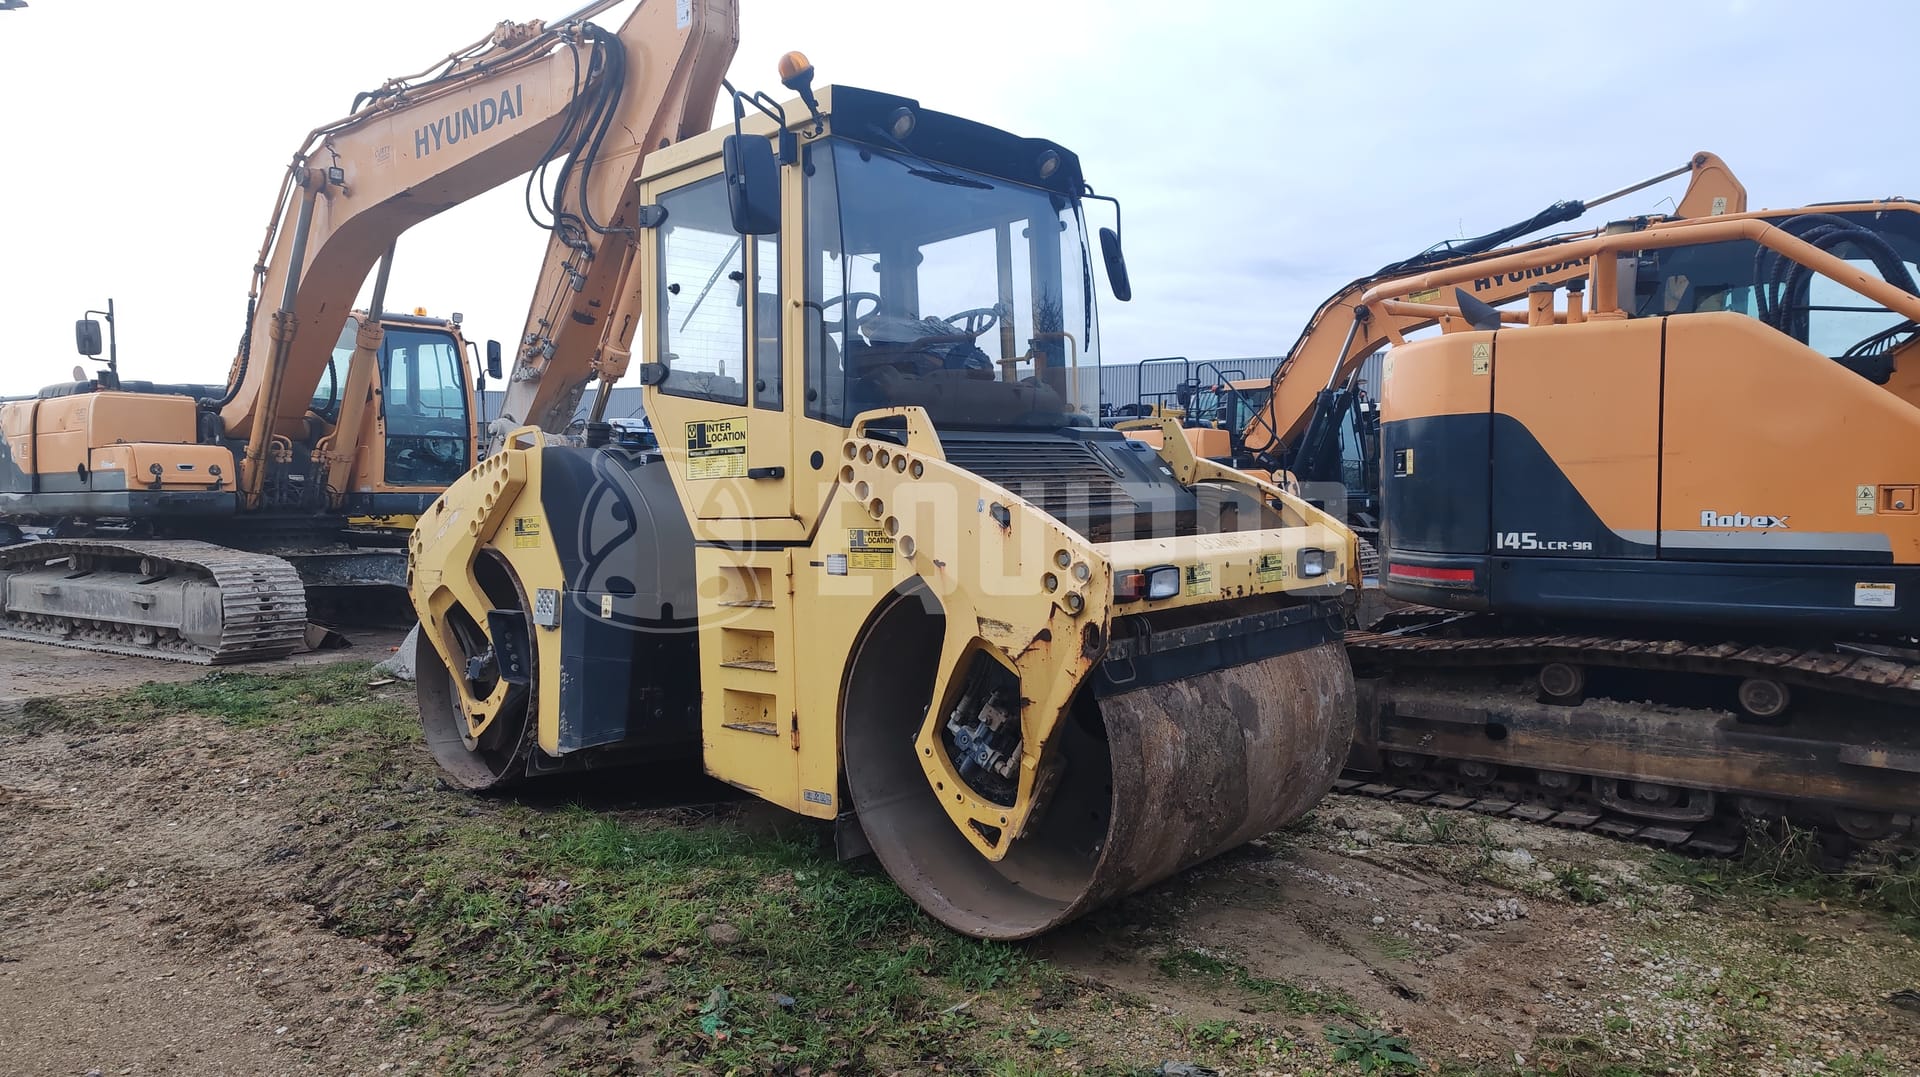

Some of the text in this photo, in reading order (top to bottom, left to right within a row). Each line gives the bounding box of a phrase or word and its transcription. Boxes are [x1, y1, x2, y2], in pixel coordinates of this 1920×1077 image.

[414, 84, 523, 159] HYUNDAI
[706, 422, 731, 432] INTER
[706, 431, 746, 443] LOCATION
[1701, 510, 1791, 528] Robex
